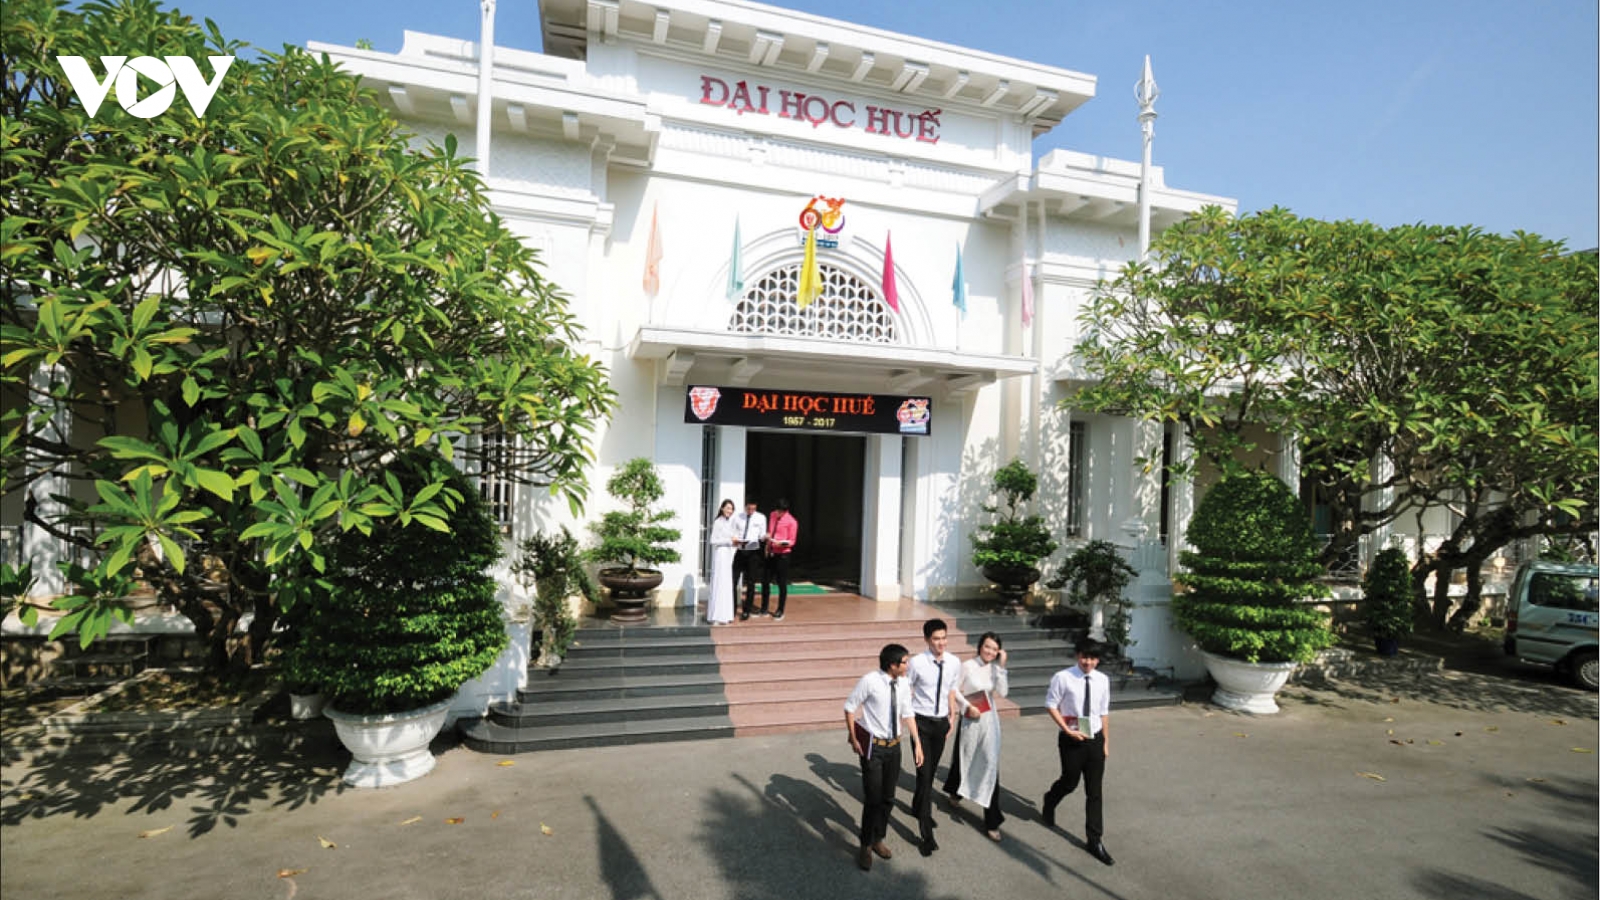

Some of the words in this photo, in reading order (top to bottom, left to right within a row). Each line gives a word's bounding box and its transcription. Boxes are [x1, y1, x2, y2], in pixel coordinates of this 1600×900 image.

[699, 75, 771, 115] ĐẠI
[778, 90, 856, 128] HỌC
[865, 106, 943, 144] HUẾ
